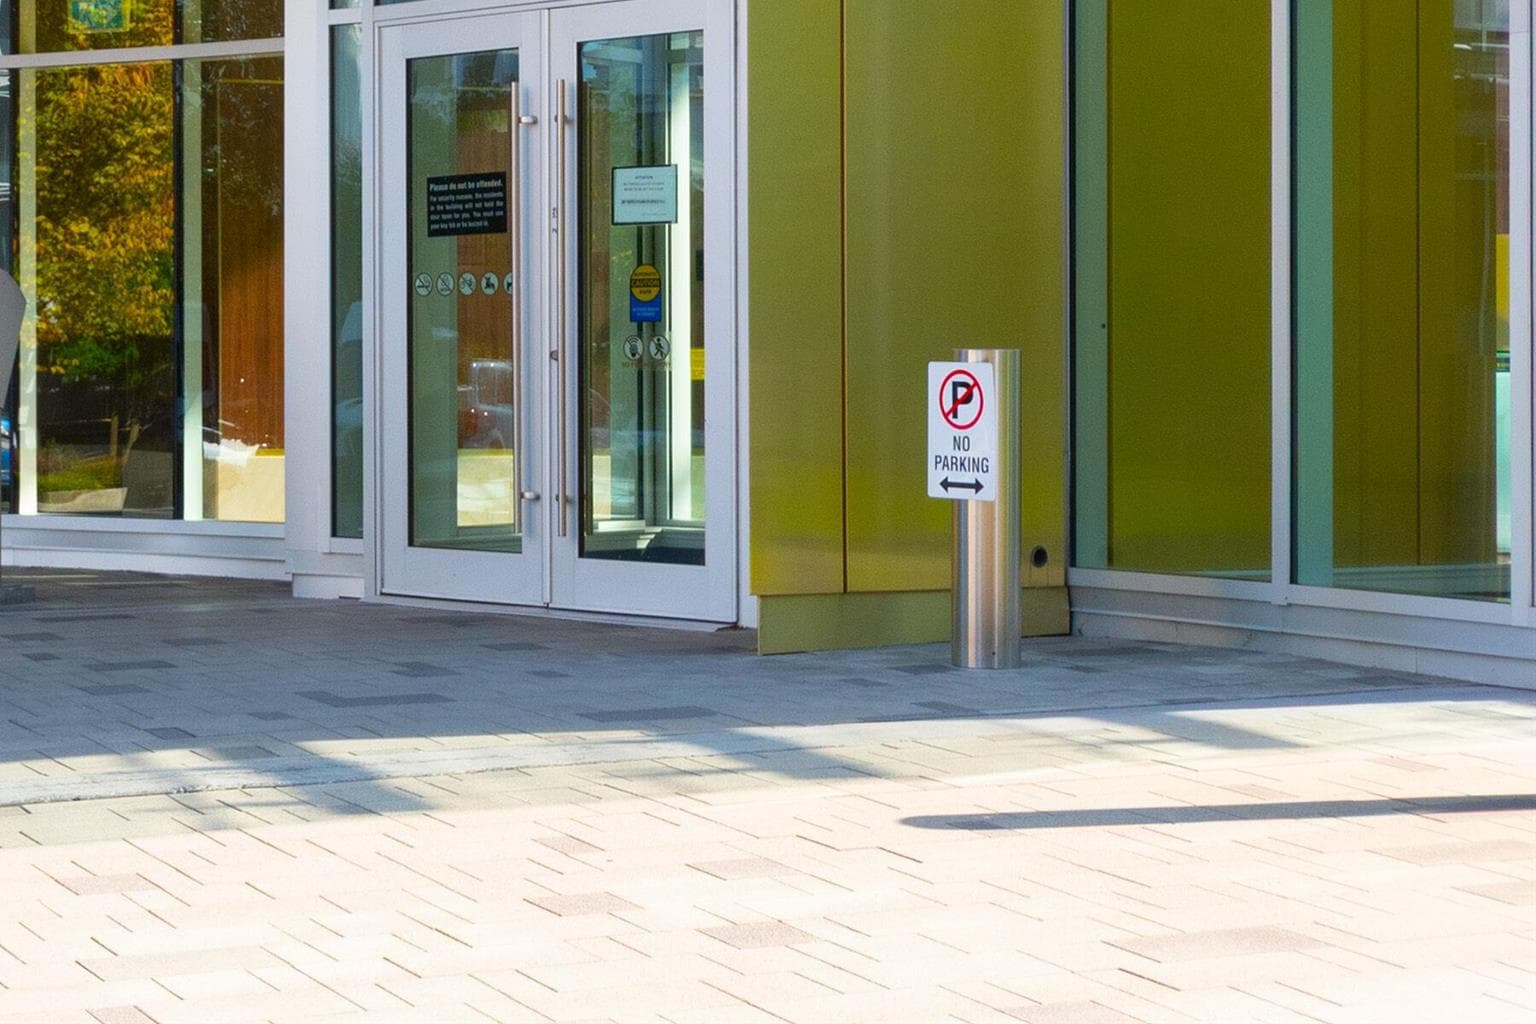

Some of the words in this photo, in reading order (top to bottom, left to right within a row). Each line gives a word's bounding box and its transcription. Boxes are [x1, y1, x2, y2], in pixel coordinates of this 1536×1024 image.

[430, 183, 448, 191] Please
[953, 435, 970, 452] NO
[934, 455, 990, 474] PARKING
